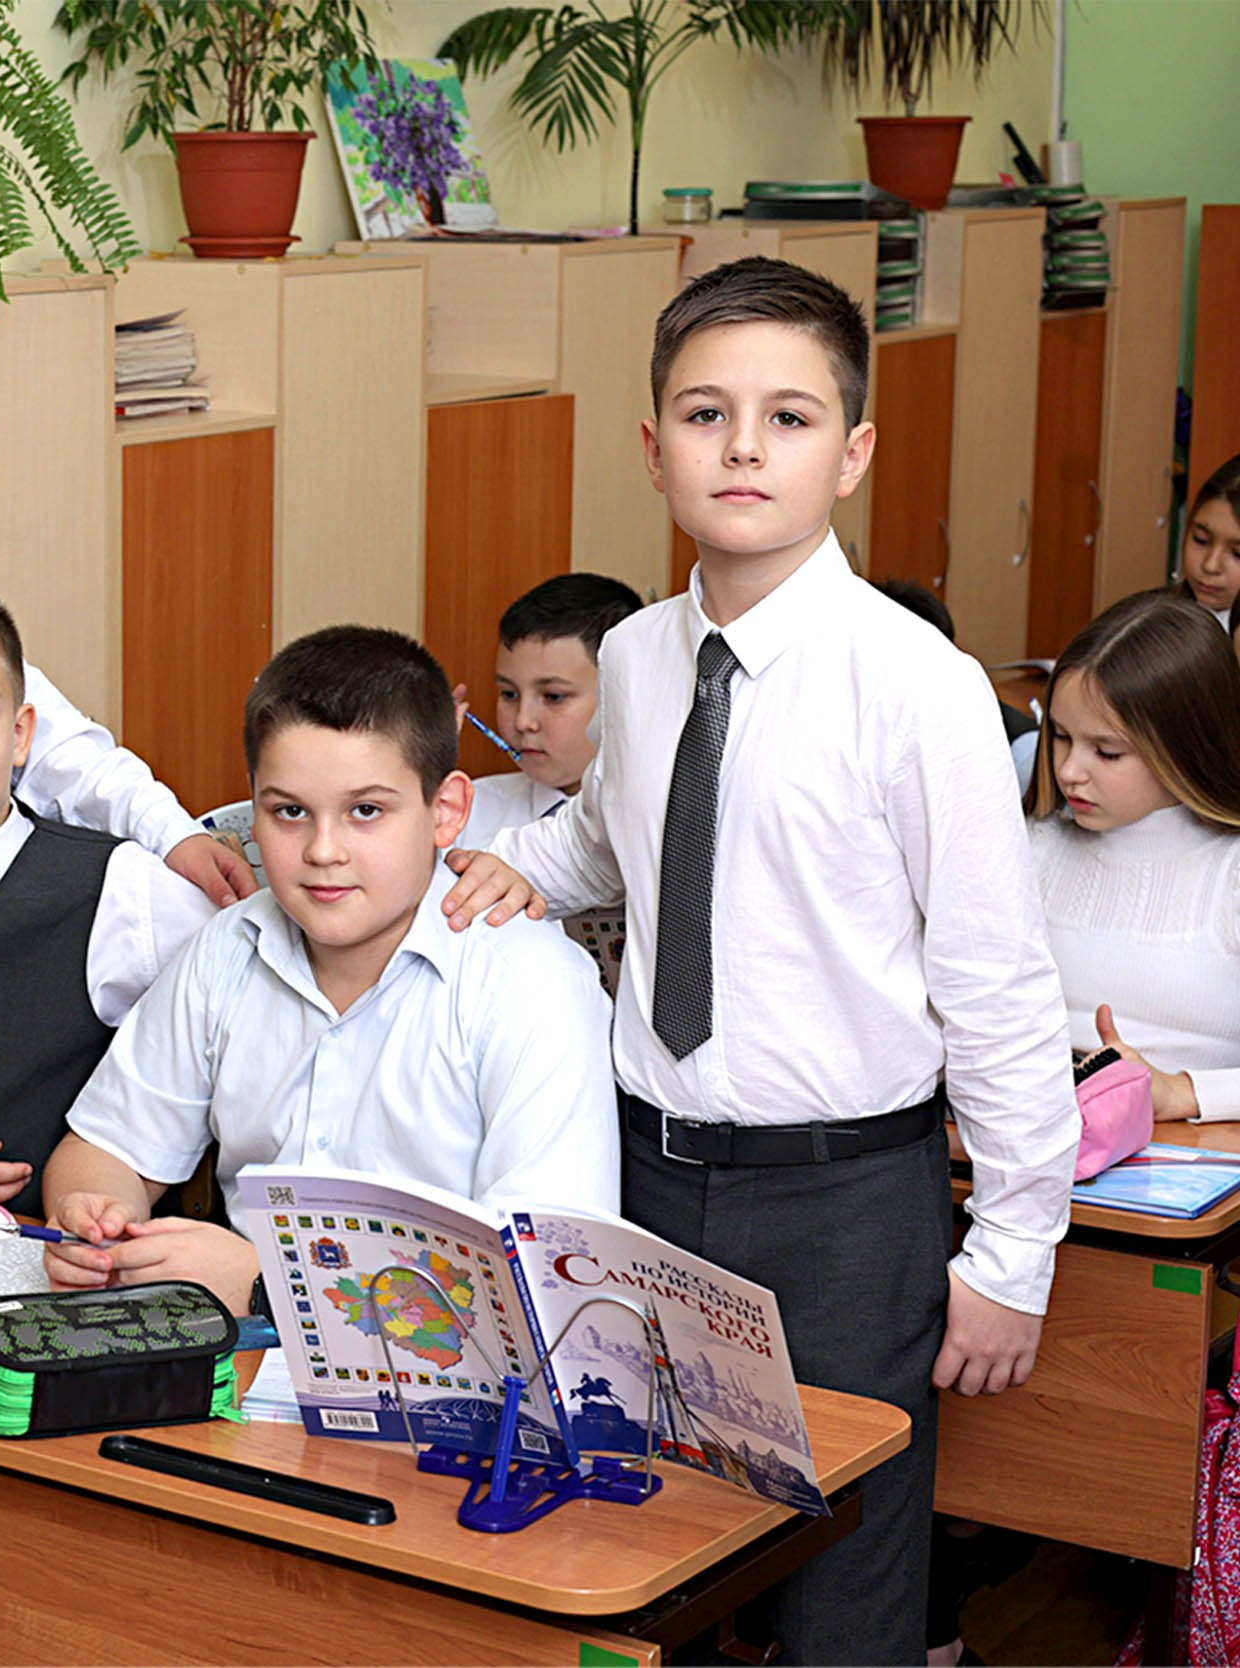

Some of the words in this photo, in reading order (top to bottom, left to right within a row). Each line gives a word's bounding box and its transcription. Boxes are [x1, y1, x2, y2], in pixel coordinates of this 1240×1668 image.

[553, 1253, 771, 1343] САМАРСКОГО
[631, 1260, 662, 1280] ПО
[668, 1274, 765, 1326] ИСТОРИИ
[659, 1260, 763, 1315] РАССКАЗЫ
[707, 1318, 773, 1359] КРАЯ
